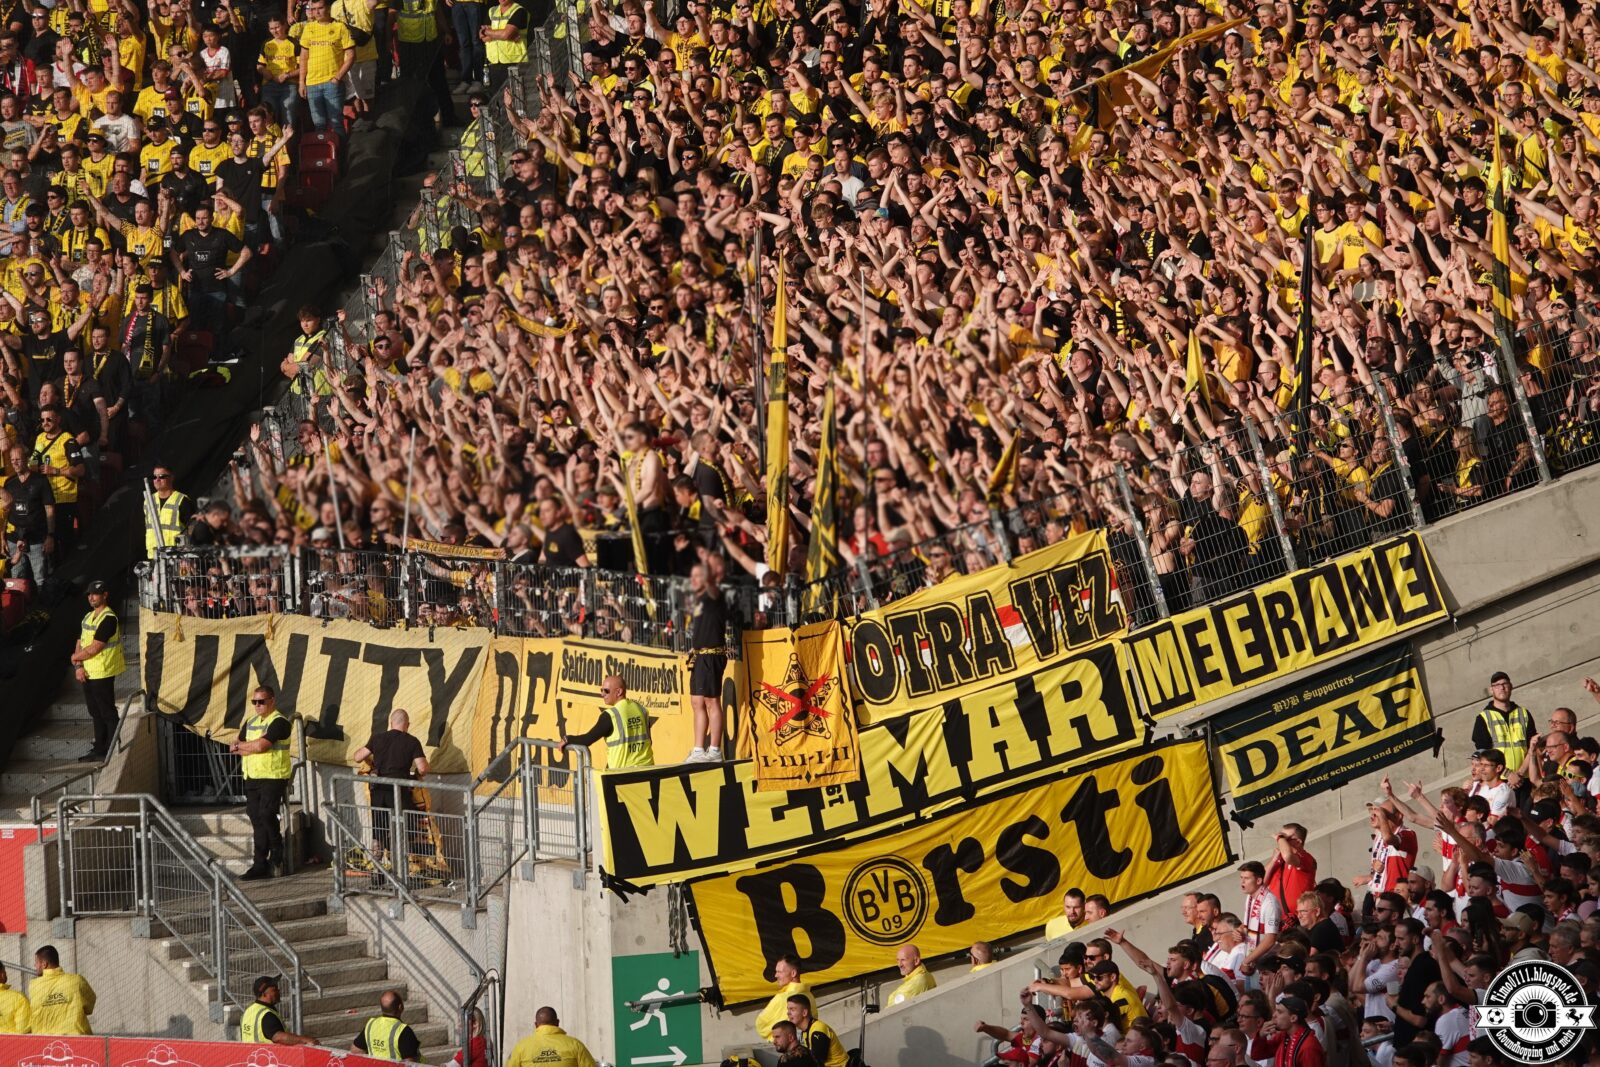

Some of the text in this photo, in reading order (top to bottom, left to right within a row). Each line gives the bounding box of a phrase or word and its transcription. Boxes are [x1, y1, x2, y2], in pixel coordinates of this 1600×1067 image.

[852, 550, 1125, 705] OTRA VEZ
[1139, 541, 1432, 707] MEERANE
[145, 632, 483, 747] UNITY
[561, 648, 602, 687] Sektion
[1271, 675, 1355, 715] BVB Supporters
[1227, 677, 1416, 789] DEAF
[1259, 739, 1414, 806] Ein Leben lang schwarz und gelb
[858, 871, 914, 924] BVB
[882, 915, 903, 932] 09
